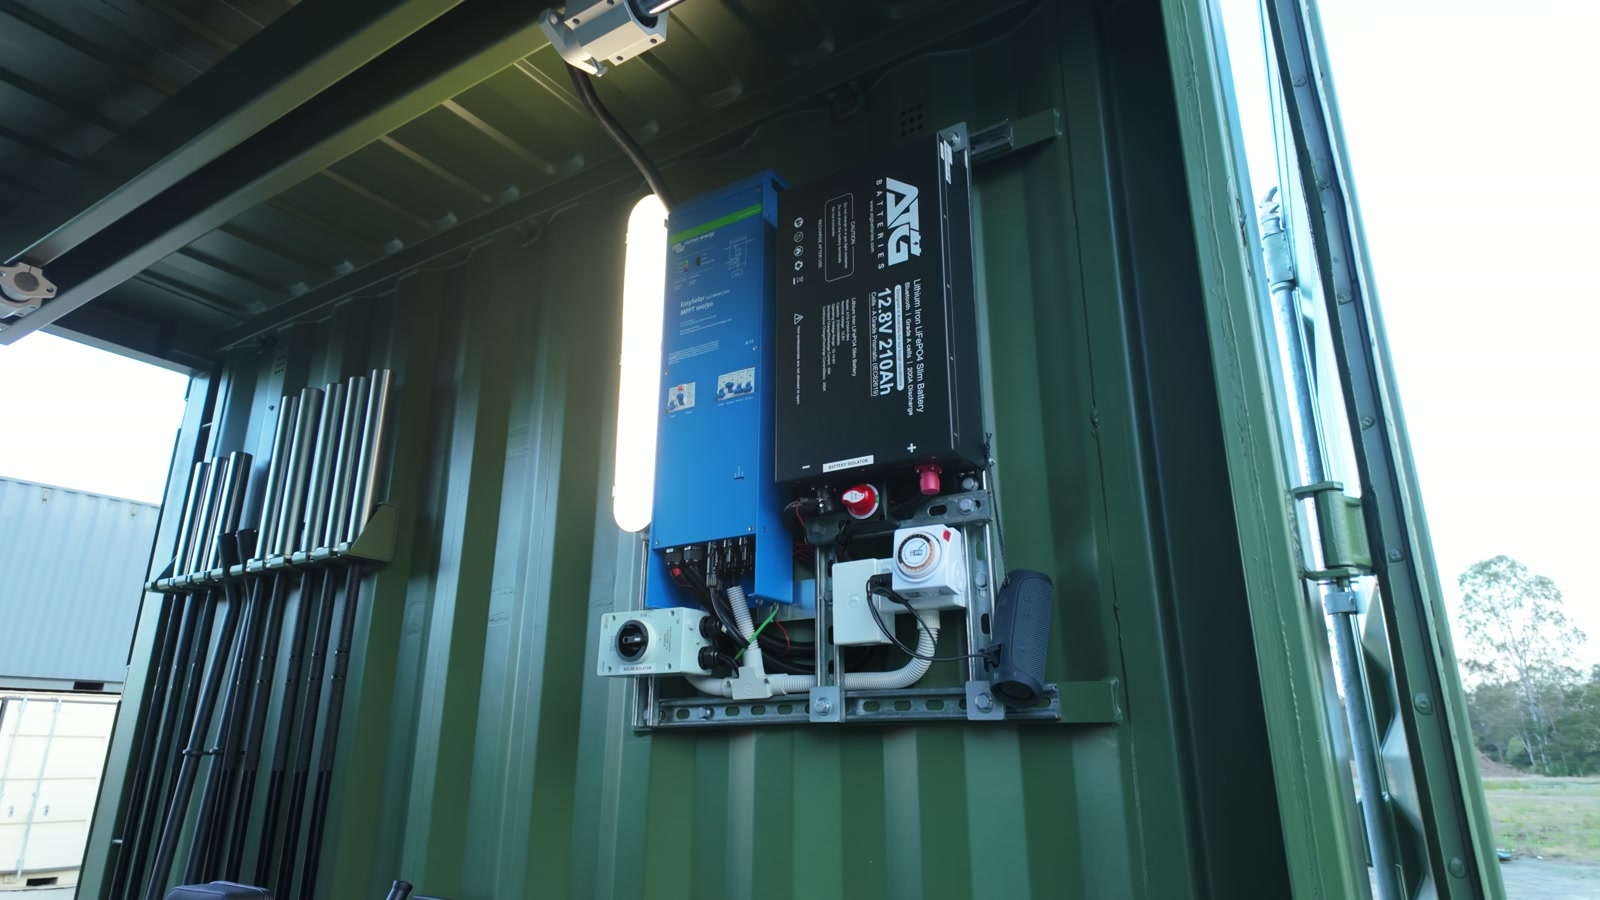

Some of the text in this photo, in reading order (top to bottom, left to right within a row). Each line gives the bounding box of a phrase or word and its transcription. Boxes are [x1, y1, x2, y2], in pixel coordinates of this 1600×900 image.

[876, 179, 884, 269] BATTERIES
[886, 177, 921, 266] ATG
[680, 296, 705, 307] EasySolar
[878, 288, 894, 395] 12.8V 210Ah
[913, 278, 925, 412] Lithium Iron LiFePO4 Slim Battery
